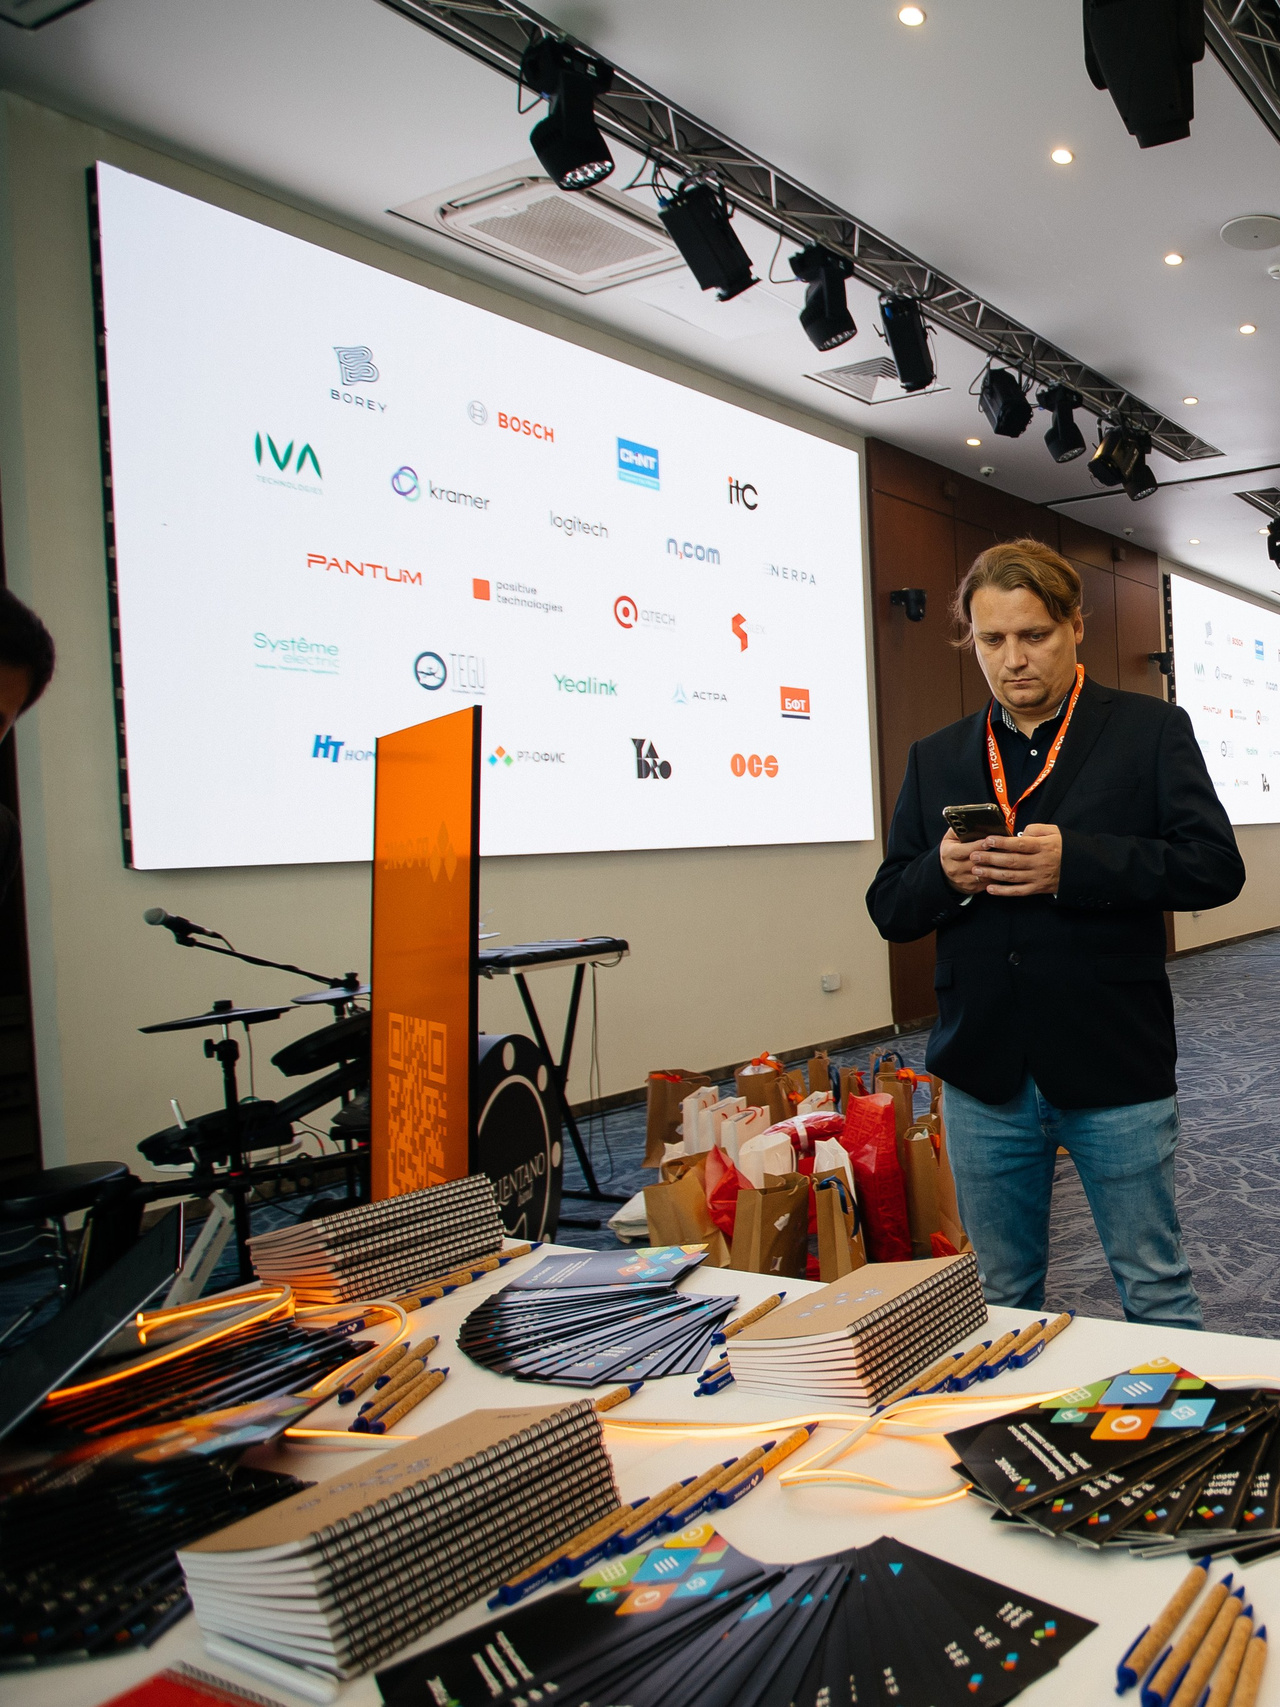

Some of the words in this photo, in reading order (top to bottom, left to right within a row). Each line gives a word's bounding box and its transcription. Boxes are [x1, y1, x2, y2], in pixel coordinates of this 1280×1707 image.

[330, 388, 388, 413] BOREY
[498, 411, 555, 443] BOSCH
[254, 430, 323, 480] IVA
[429, 481, 490, 510] kramer
[549, 510, 609, 539] logitech
[306, 553, 423, 586] PANTUM
[769, 563, 817, 586] NERPA
[496, 580, 538, 596] positive
[496, 594, 564, 613] technologies
[641, 609, 676, 626] QTECH
[283, 651, 340, 668] electric
[554, 673, 618, 697] Yealink
[784, 697, 806, 712] БФТ
[517, 750, 566, 764] Р7-ОФИС
[730, 753, 779, 778] OCS
[994, 778, 1004, 793] OCS
